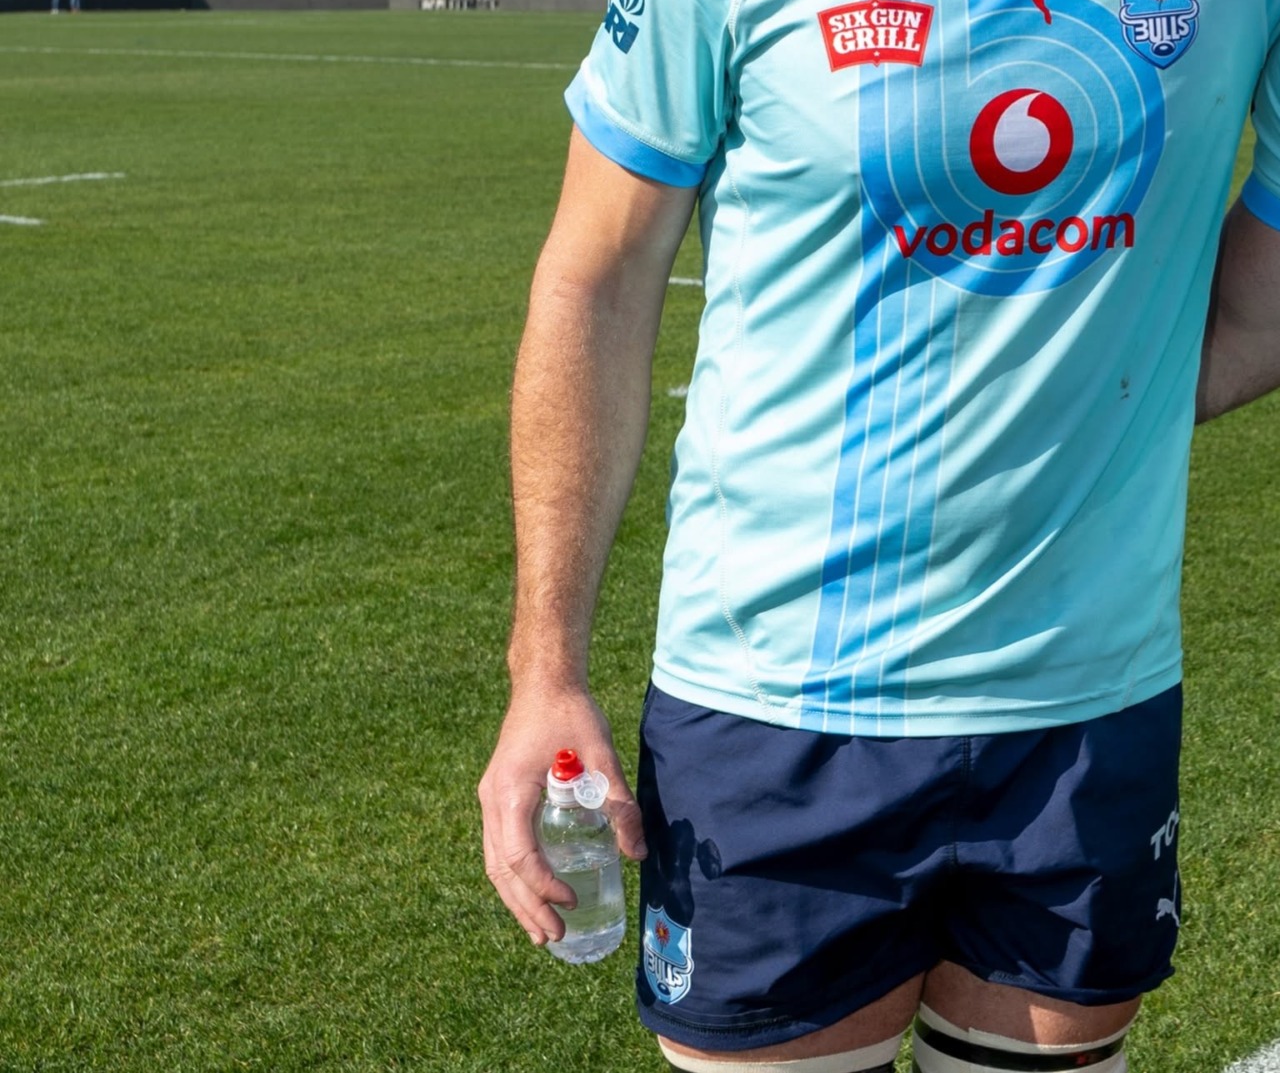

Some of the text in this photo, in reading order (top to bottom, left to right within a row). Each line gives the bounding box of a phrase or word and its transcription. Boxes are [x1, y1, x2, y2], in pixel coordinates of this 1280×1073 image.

[828, 8, 924, 33] SIX GUN
[1133, 14, 1191, 44] BULLS
[832, 27, 921, 55] GRILL
[892, 208, 1135, 260] vodacom
